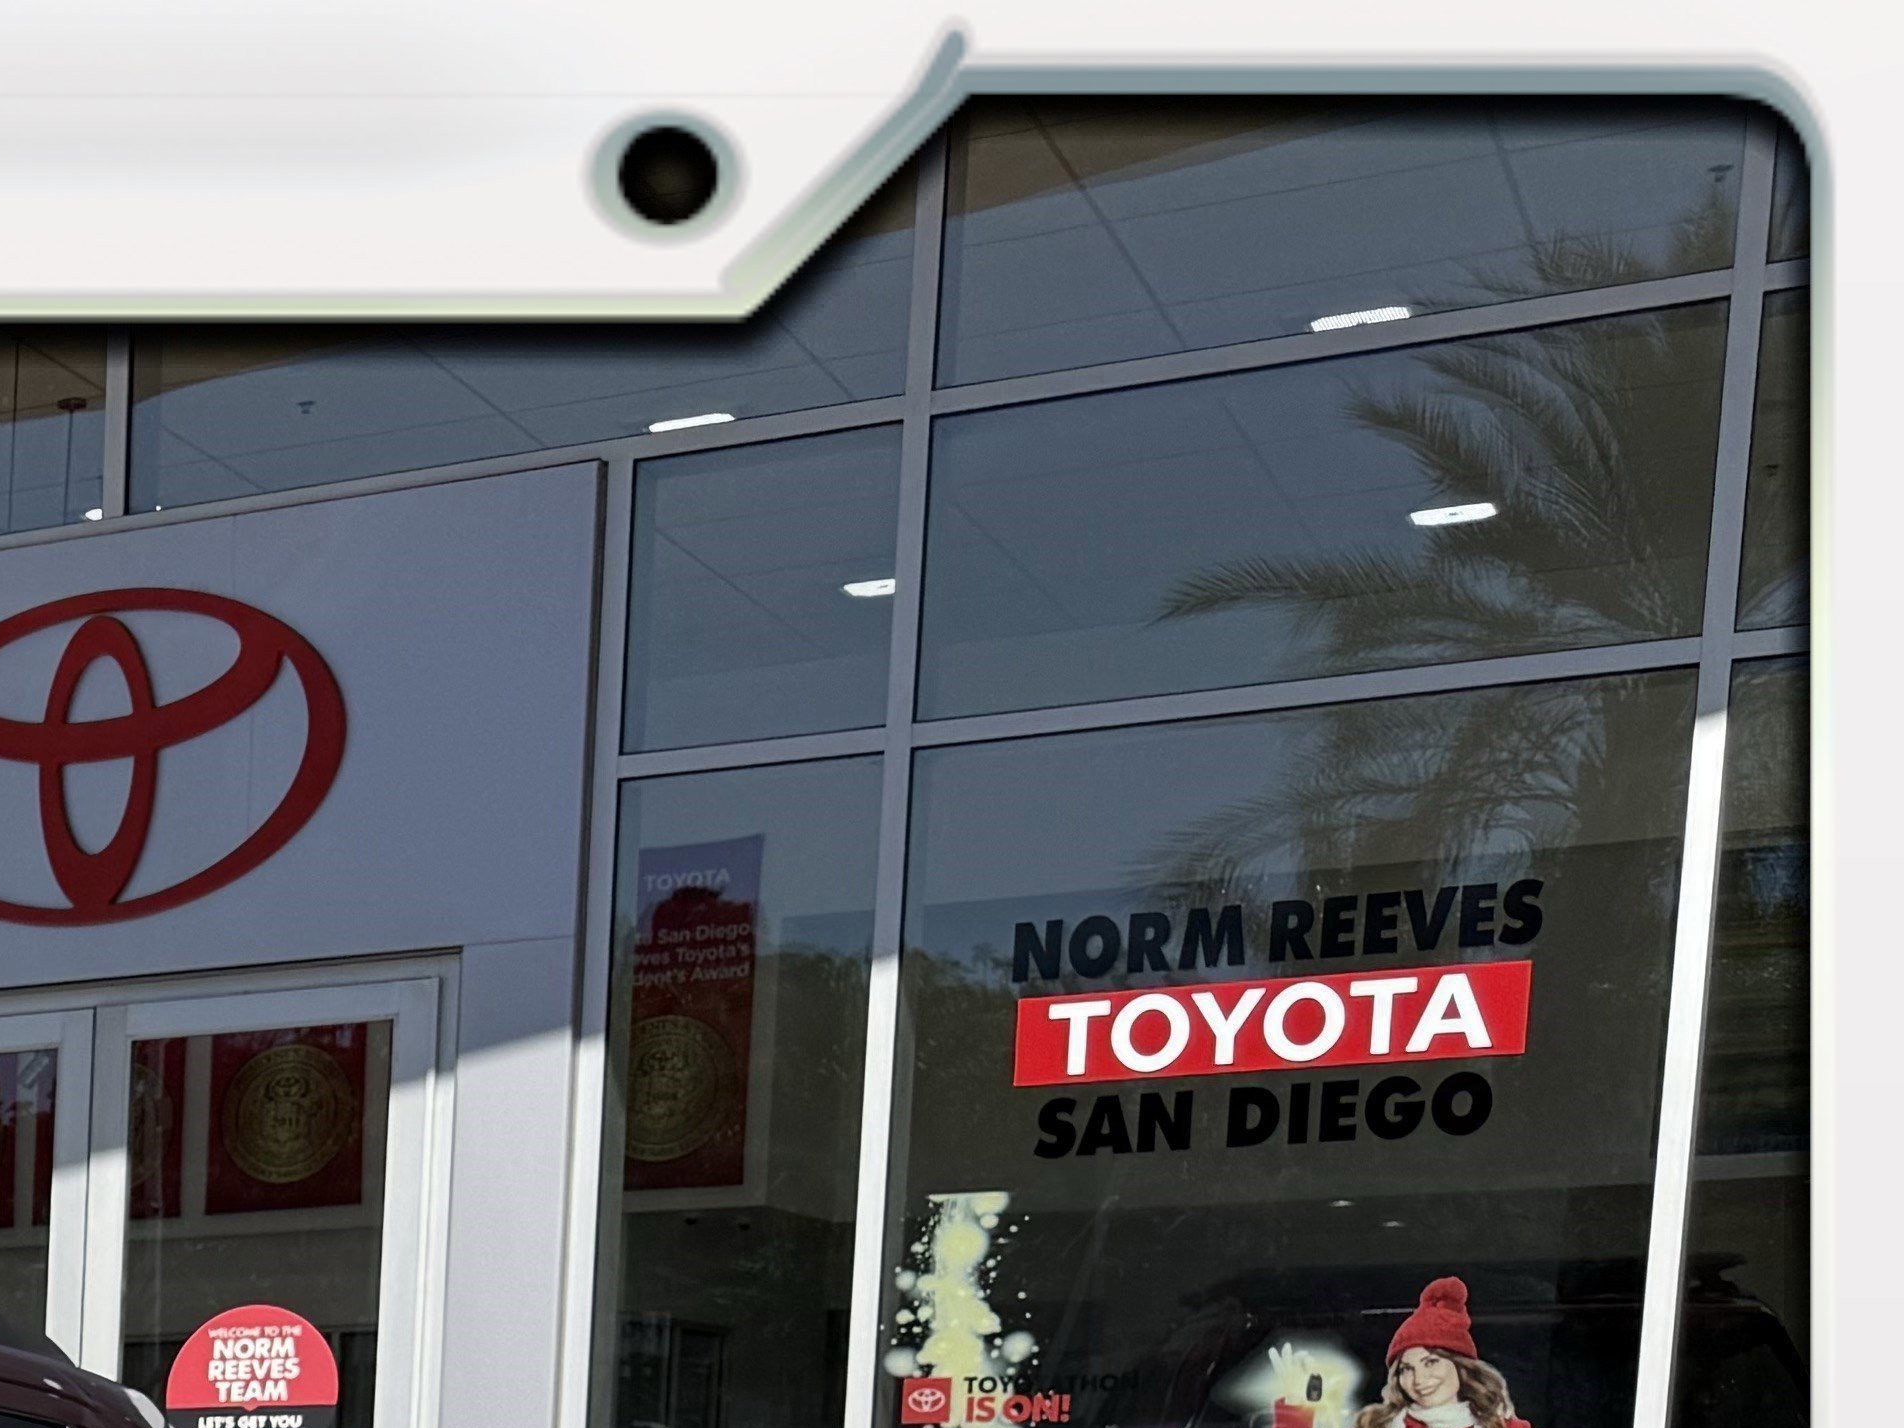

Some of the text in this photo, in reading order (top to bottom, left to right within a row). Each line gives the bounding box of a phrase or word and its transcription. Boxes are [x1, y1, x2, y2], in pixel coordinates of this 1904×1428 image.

[643, 868, 731, 892] TOYOTA
[657, 928, 691, 944] San
[696, 923, 750, 942] Diego
[1012, 878, 1544, 983] NORM REEVES
[676, 942, 750, 964] Toyota's
[690, 962, 750, 981] Award
[1048, 972, 1493, 1076] TOYOTA
[1034, 1071, 1493, 1158] SAN DIEGO
[208, 1325, 302, 1338] WELCOME TO THE
[213, 1337, 296, 1359] NORM
[208, 1358, 301, 1381] REEVES
[215, 1379, 289, 1402] TEAM
[965, 1394, 1071, 1423] IS ON!
[237, 1415, 267, 1428] GET
[270, 1415, 303, 1428] YOU
